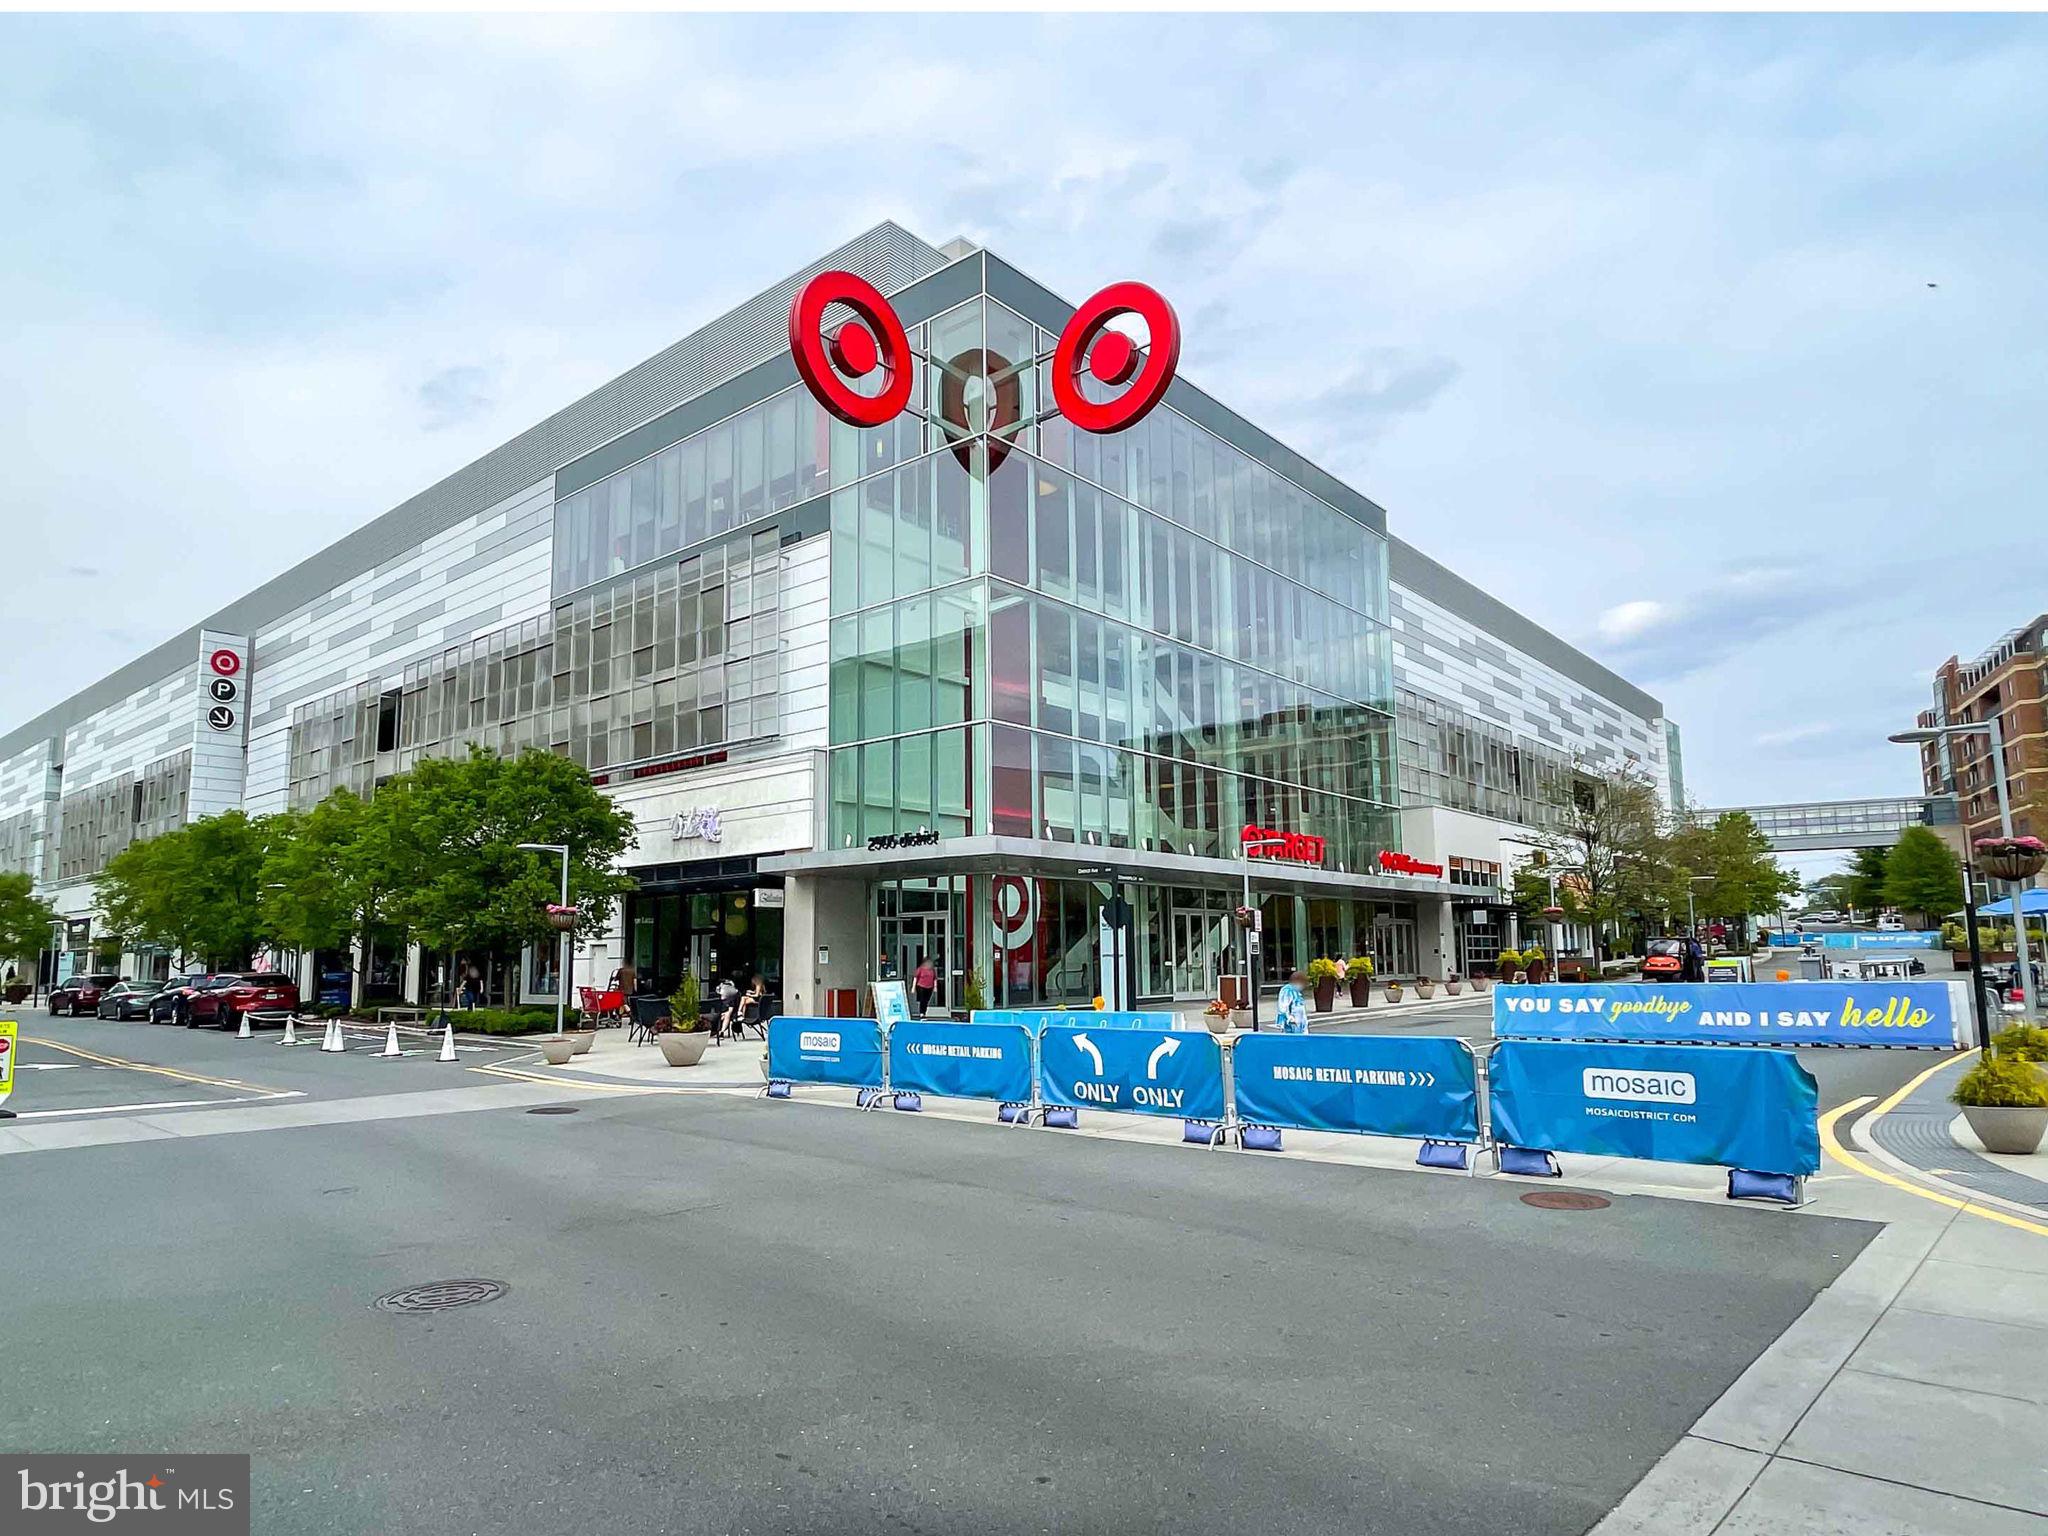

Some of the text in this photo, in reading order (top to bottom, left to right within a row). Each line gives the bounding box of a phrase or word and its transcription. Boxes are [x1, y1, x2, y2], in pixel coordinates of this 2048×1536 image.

[217, 682, 231, 696] P
[1263, 830, 1325, 865] TARGET
[1505, 995, 1936, 1028] YOU SAY goodbye AND I SAY hello
[803, 1036, 837, 1048] mosaic
[923, 1044, 1003, 1060] MOSAIC RETAIL PARKING
[1273, 1066, 1406, 1086] MOSAIC RETAIL PARKING
[1592, 1075, 1686, 1096] mosaic
[1074, 1081, 1184, 1108] ONLY ONLY
